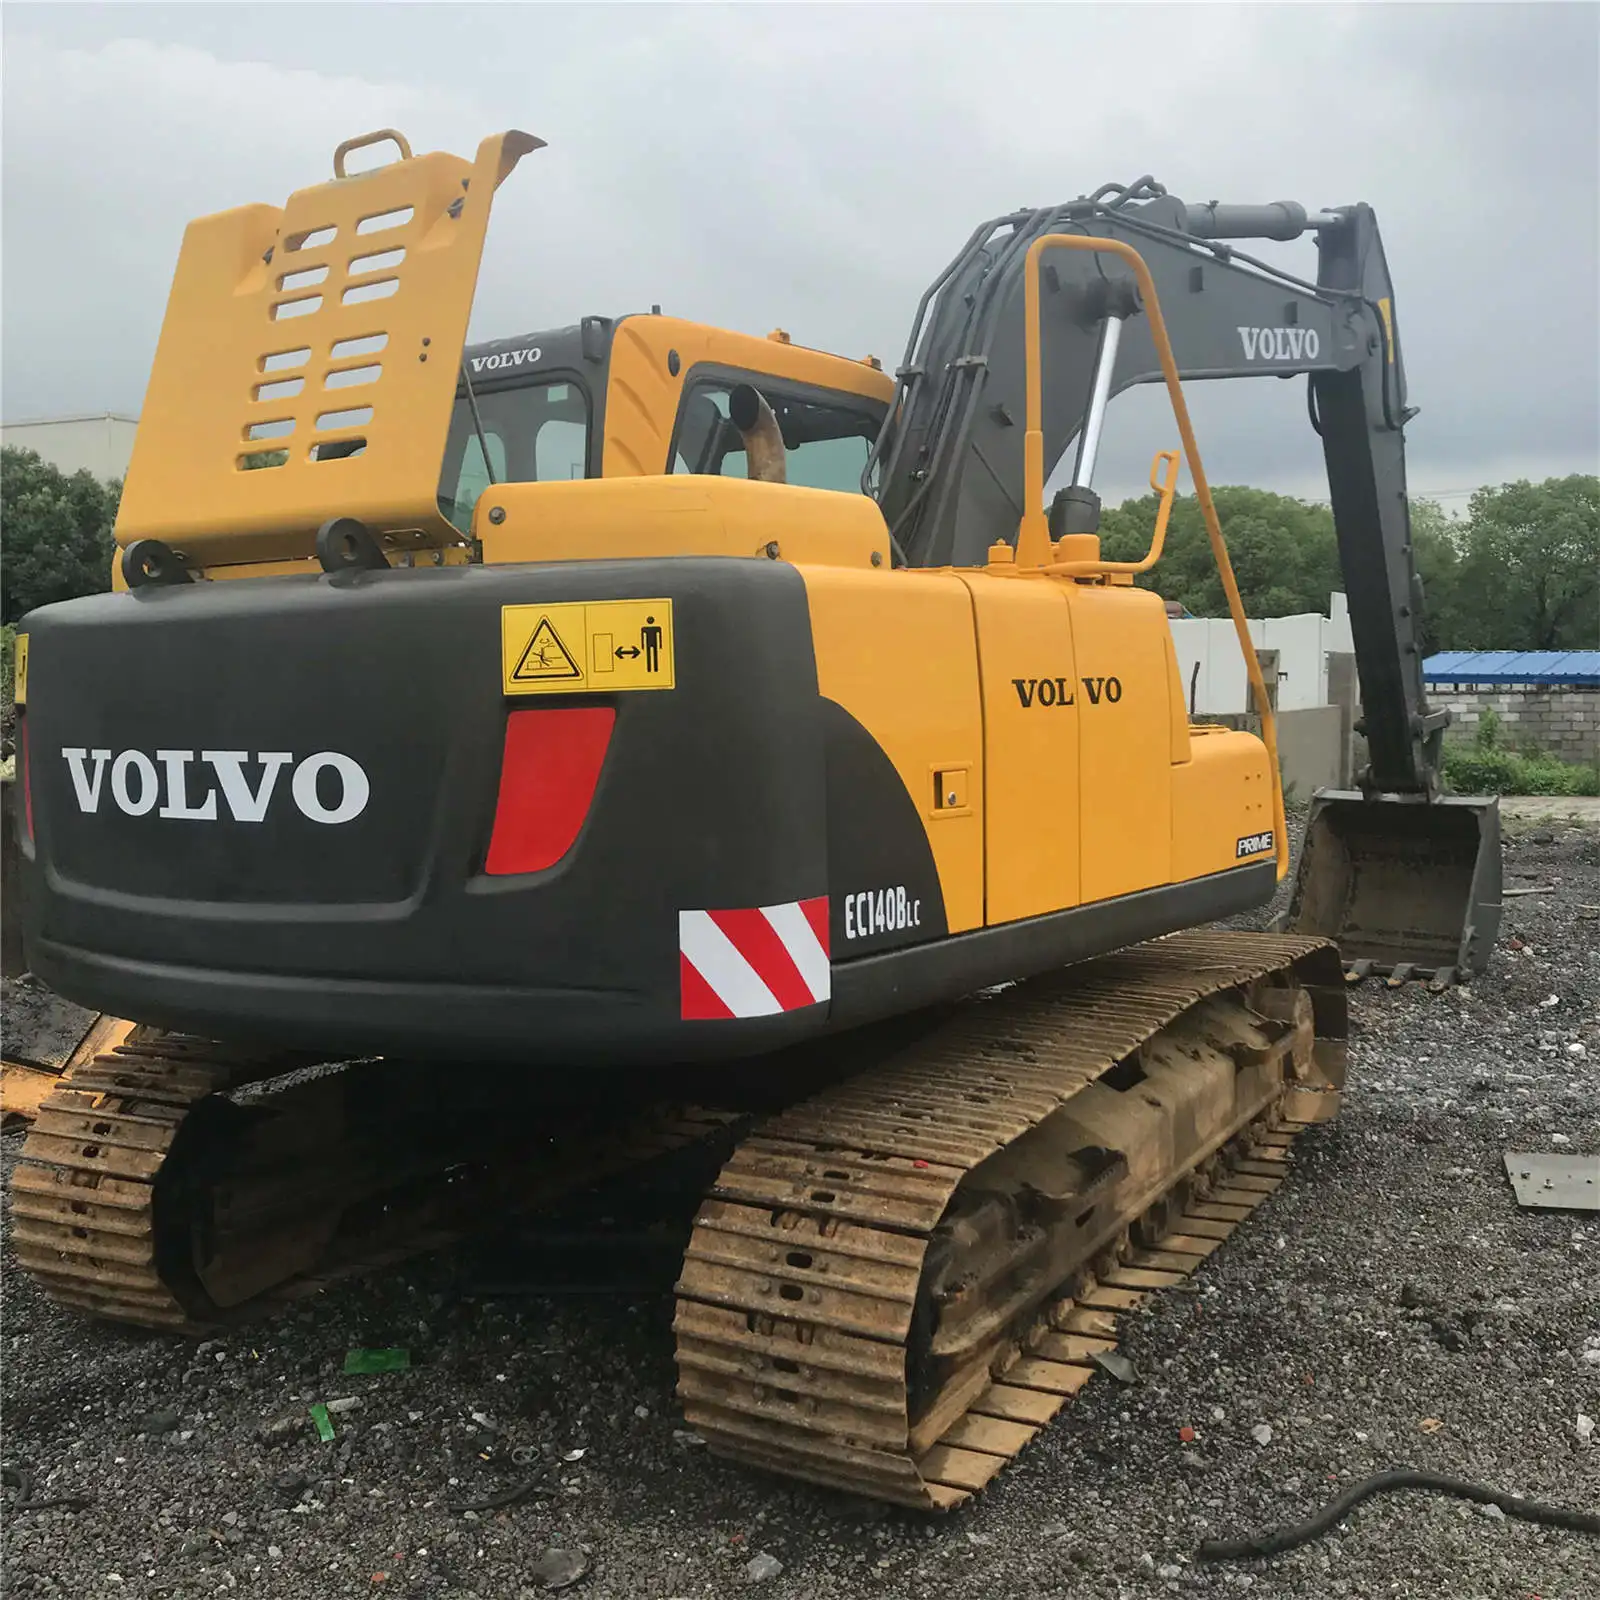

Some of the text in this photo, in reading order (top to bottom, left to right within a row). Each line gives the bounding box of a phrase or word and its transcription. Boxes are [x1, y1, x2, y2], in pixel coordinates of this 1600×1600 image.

[1236, 326, 1320, 360] VOLVO
[470, 347, 542, 373] VOLVO
[61, 747, 370, 824] VOLVO
[1237, 832, 1272, 857] PRIME
